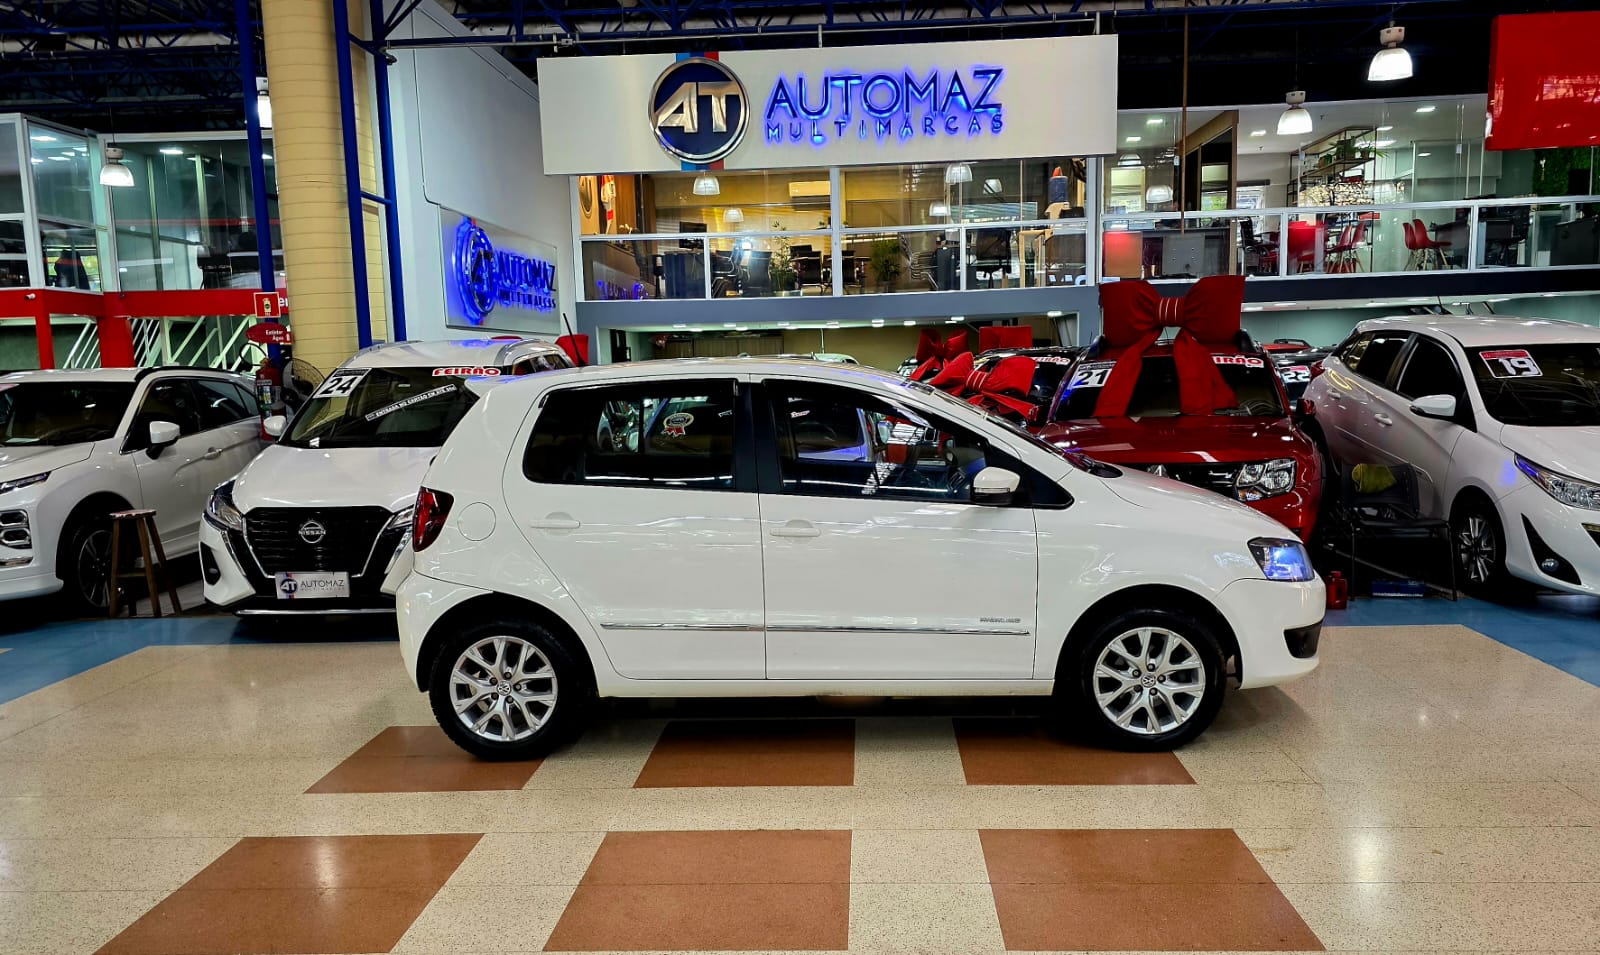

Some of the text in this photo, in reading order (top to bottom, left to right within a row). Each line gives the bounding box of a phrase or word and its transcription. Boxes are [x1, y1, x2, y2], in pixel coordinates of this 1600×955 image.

[766, 68, 1003, 119] AUTOMAZ
[653, 81, 742, 133] AT
[767, 114, 1003, 142] MULTIMARCAS
[432, 366, 501, 376] FEIRÃO
[1498, 358, 1540, 375] 19
[319, 376, 358, 395] 24
[1072, 369, 1109, 386] 21
[1281, 371, 1310, 383] 22
[300, 579, 345, 588] AUTOMAZ
